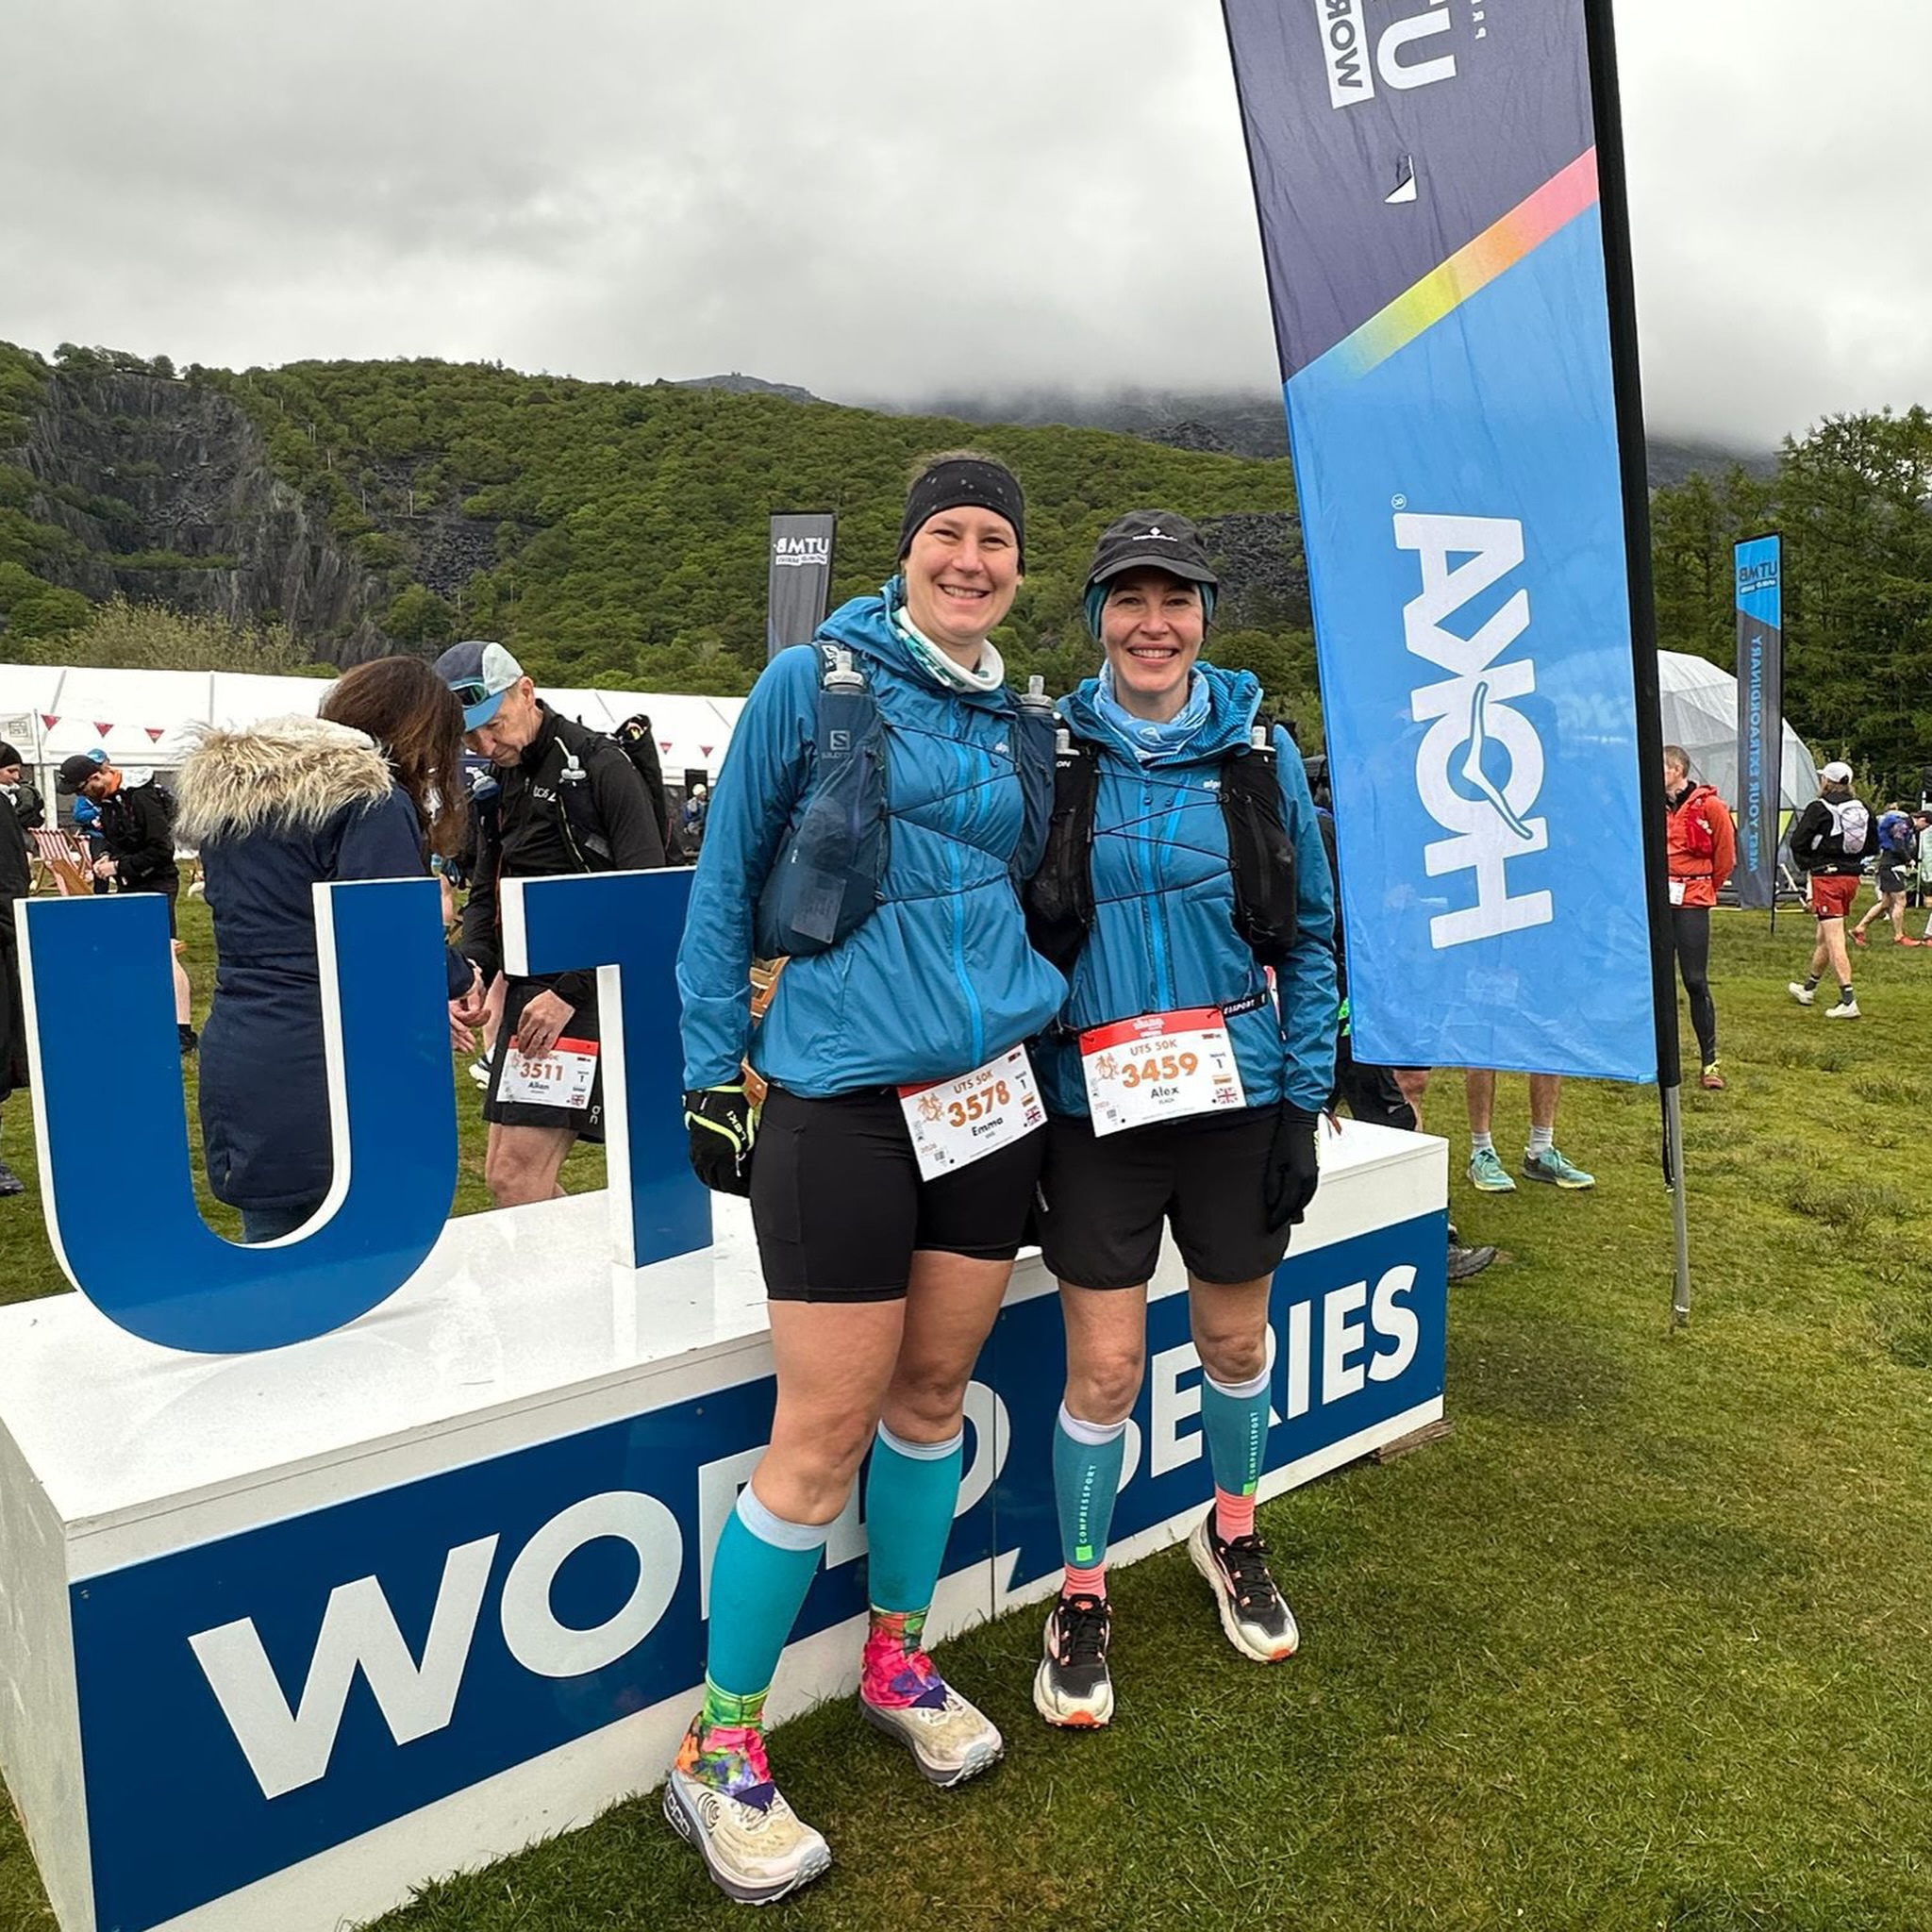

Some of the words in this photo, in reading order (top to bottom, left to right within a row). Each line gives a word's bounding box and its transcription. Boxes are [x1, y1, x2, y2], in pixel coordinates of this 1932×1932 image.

[1129, 1042, 1152, 1057] UTS
[1156, 1039, 1178, 1052] 50K
[520, 1061, 564, 1082] 3511
[953, 1078, 974, 1094] UTS
[975, 1069, 995, 1086] 50K
[1122, 1052, 1199, 1088] 3459
[947, 1079, 1011, 1128] 3578
[972, 1117, 1005, 1137] Emma
[1115, 1264, 1419, 1494] EIES
[1078, 1465, 1097, 1544] COMPRESSPORT
